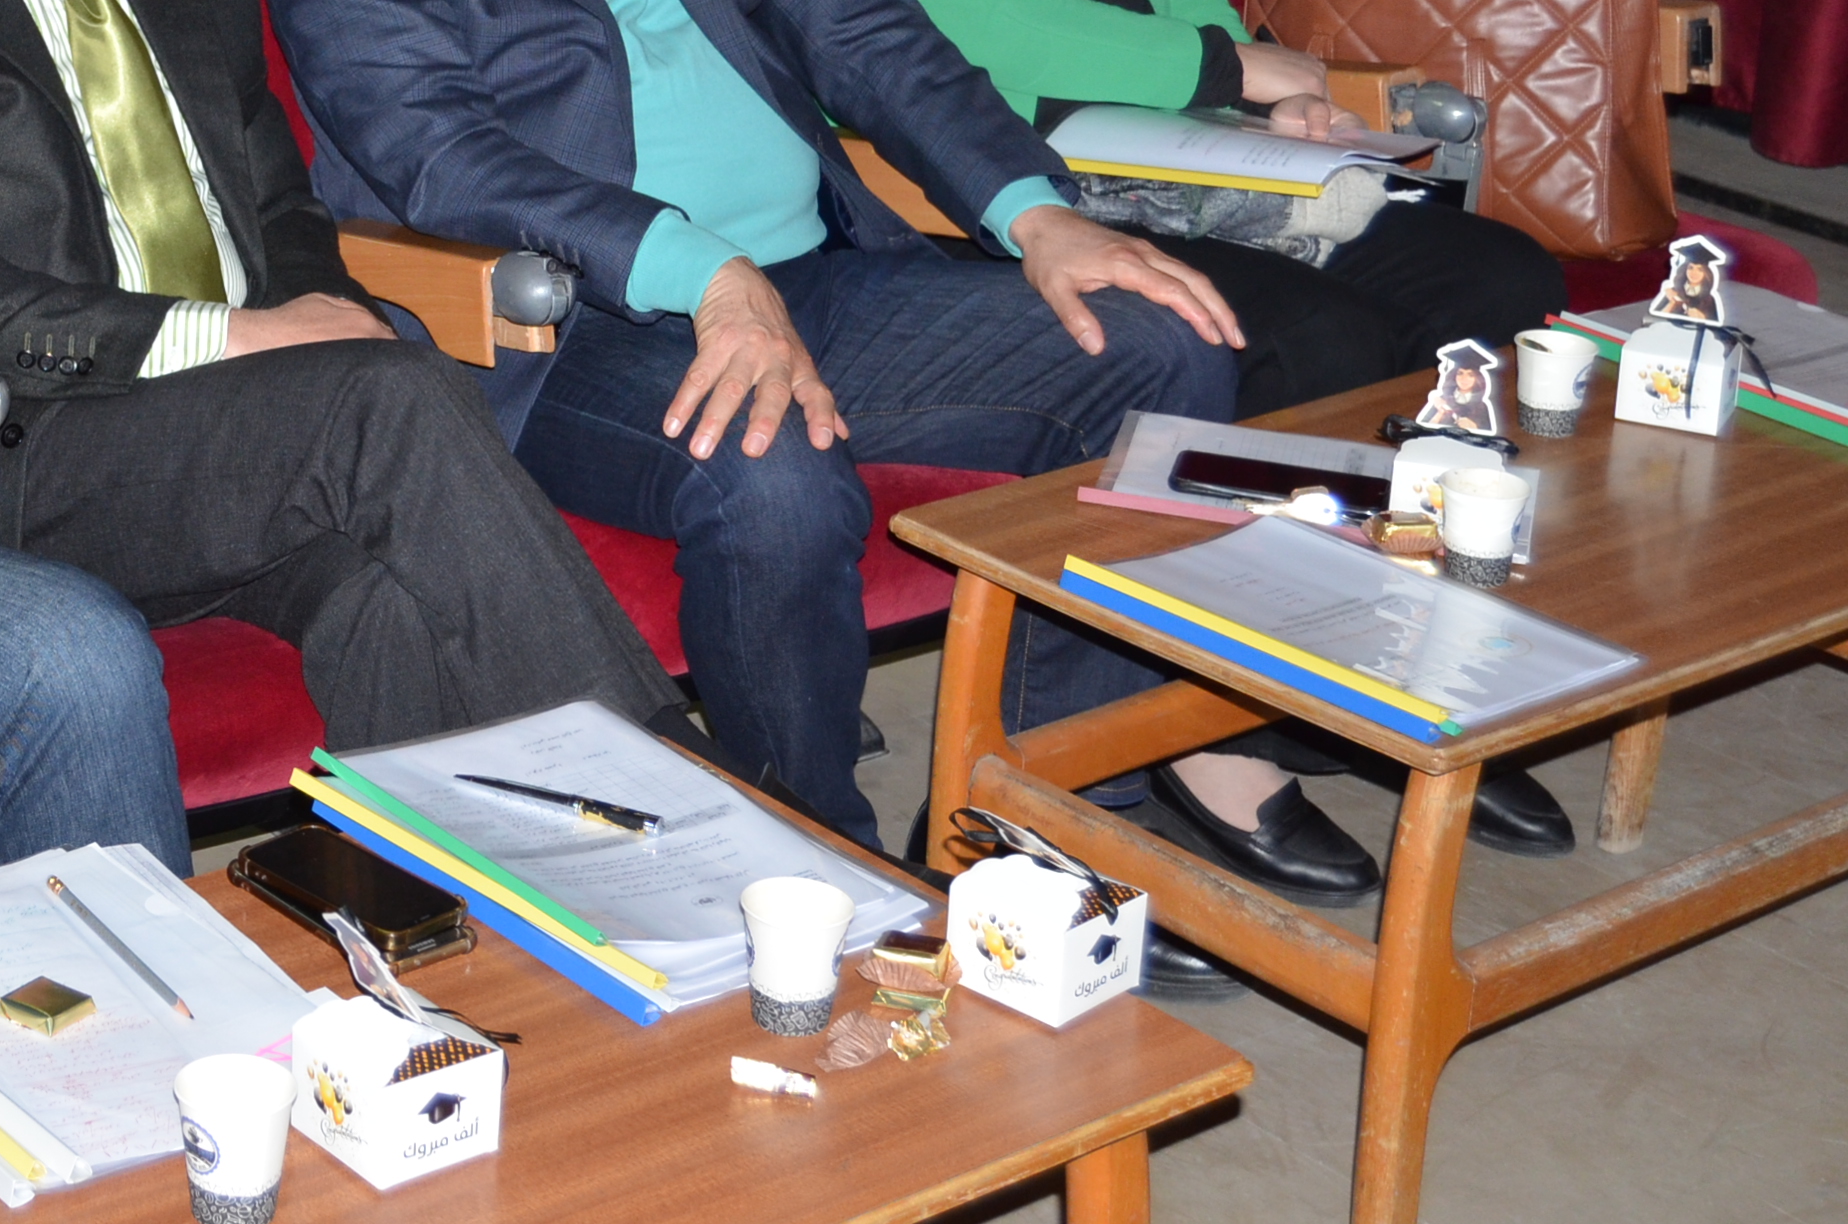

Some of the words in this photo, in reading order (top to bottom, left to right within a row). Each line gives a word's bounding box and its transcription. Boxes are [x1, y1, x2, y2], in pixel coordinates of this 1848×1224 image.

[1109, 955, 1129, 980] ألف
[1074, 973, 1107, 998] مبروك
[454, 1116, 479, 1142] ألف
[403, 1135, 449, 1160] مبروك
